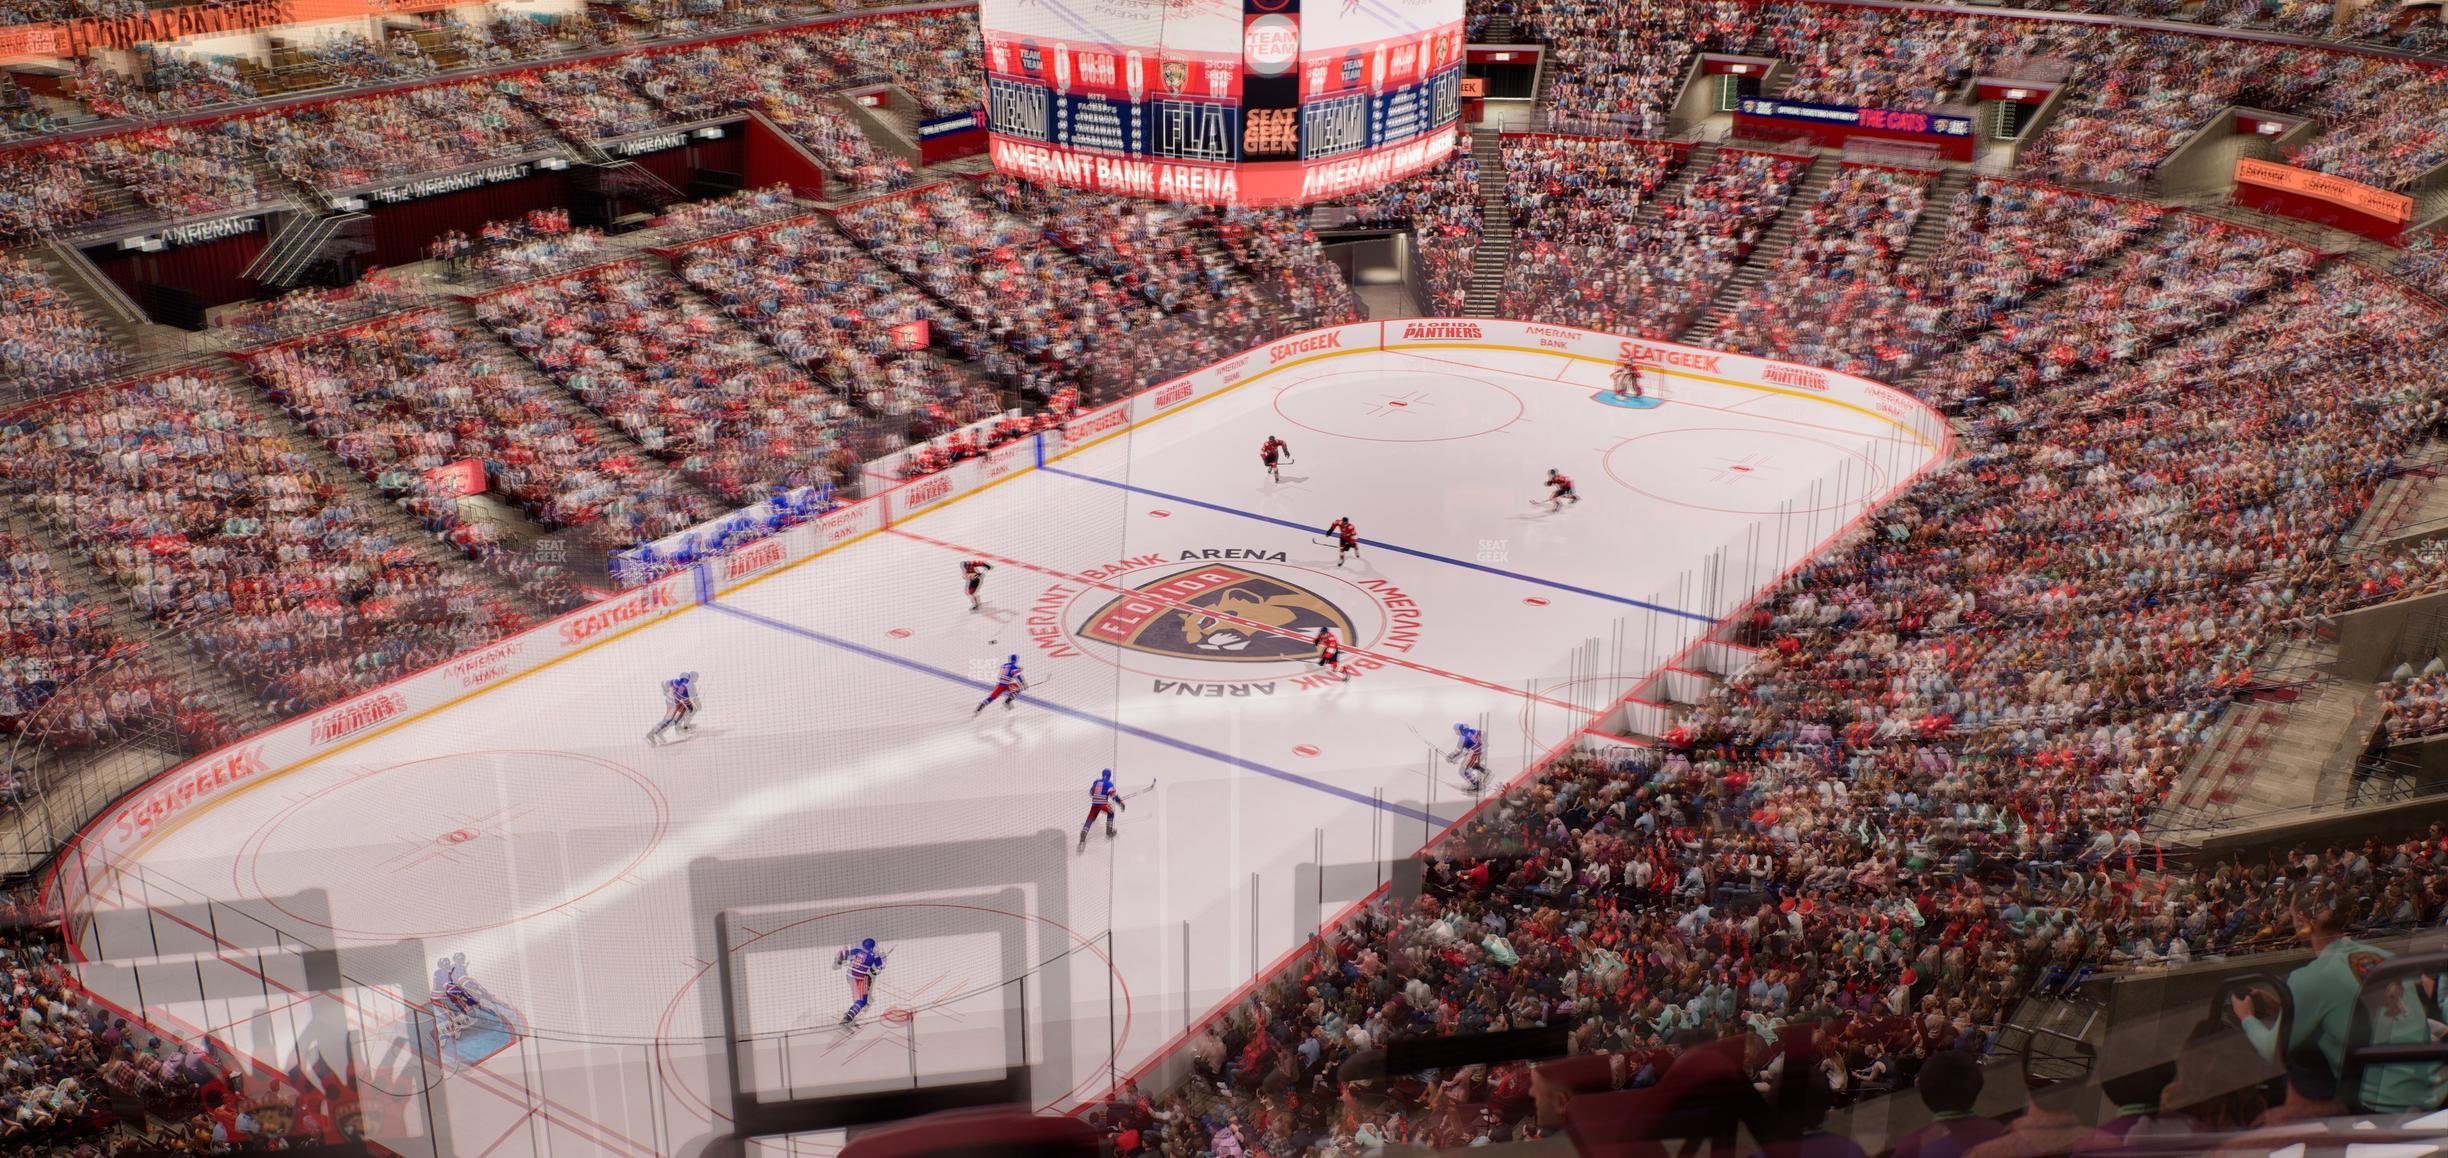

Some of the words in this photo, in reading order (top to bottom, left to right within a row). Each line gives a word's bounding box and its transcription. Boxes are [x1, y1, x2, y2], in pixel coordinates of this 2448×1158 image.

[1247, 44, 1296, 55] TEAM
[1248, 32, 1297, 44] TEAM
[1246, 107, 1297, 124] SEAT
[1163, 99, 1229, 163] FLA
[997, 141, 1094, 186] AMERANT
[1096, 157, 1156, 194] BANK
[1159, 165, 1239, 201] ARENA
[1302, 150, 1394, 199] AMERANT
[1402, 327, 1483, 339] PANTHERS
[1525, 326, 1583, 341] AMERANT
[1540, 338, 1568, 350] BANK
[1269, 330, 1342, 364] SEATGEEK
[1619, 341, 1722, 374] SEATGEEK
[1027, 583, 1078, 660] AMERANT
[1081, 553, 1170, 581] BANK
[1179, 548, 1288, 563] ARENA
[1357, 578, 1422, 655] AMERANT
[1152, 679, 1278, 698] ARENA
